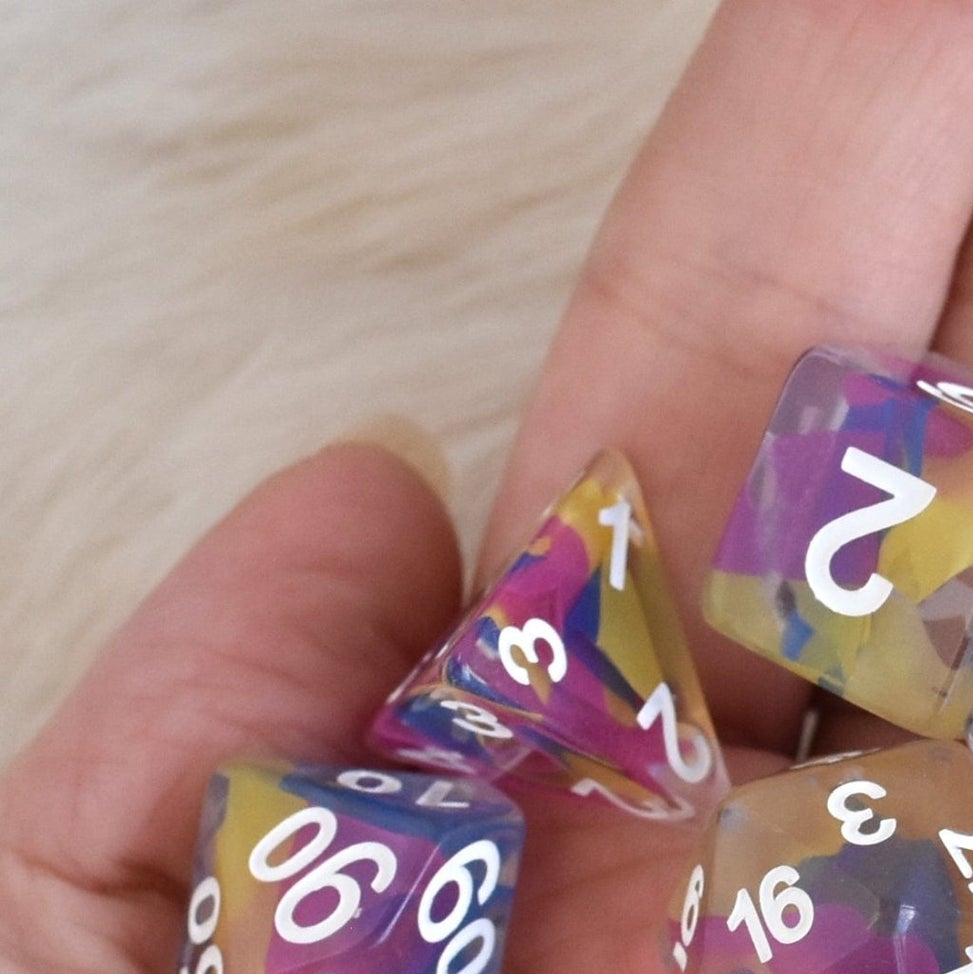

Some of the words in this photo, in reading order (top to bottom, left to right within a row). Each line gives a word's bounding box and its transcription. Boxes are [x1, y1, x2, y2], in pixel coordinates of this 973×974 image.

[598, 498, 632, 591] 1
[804, 446, 938, 617] 2
[498, 617, 568, 686] 3
[440, 700, 514, 739] 3
[636, 682, 711, 783] 2
[826, 780, 897, 847] 3
[727, 865, 815, 964] 16
